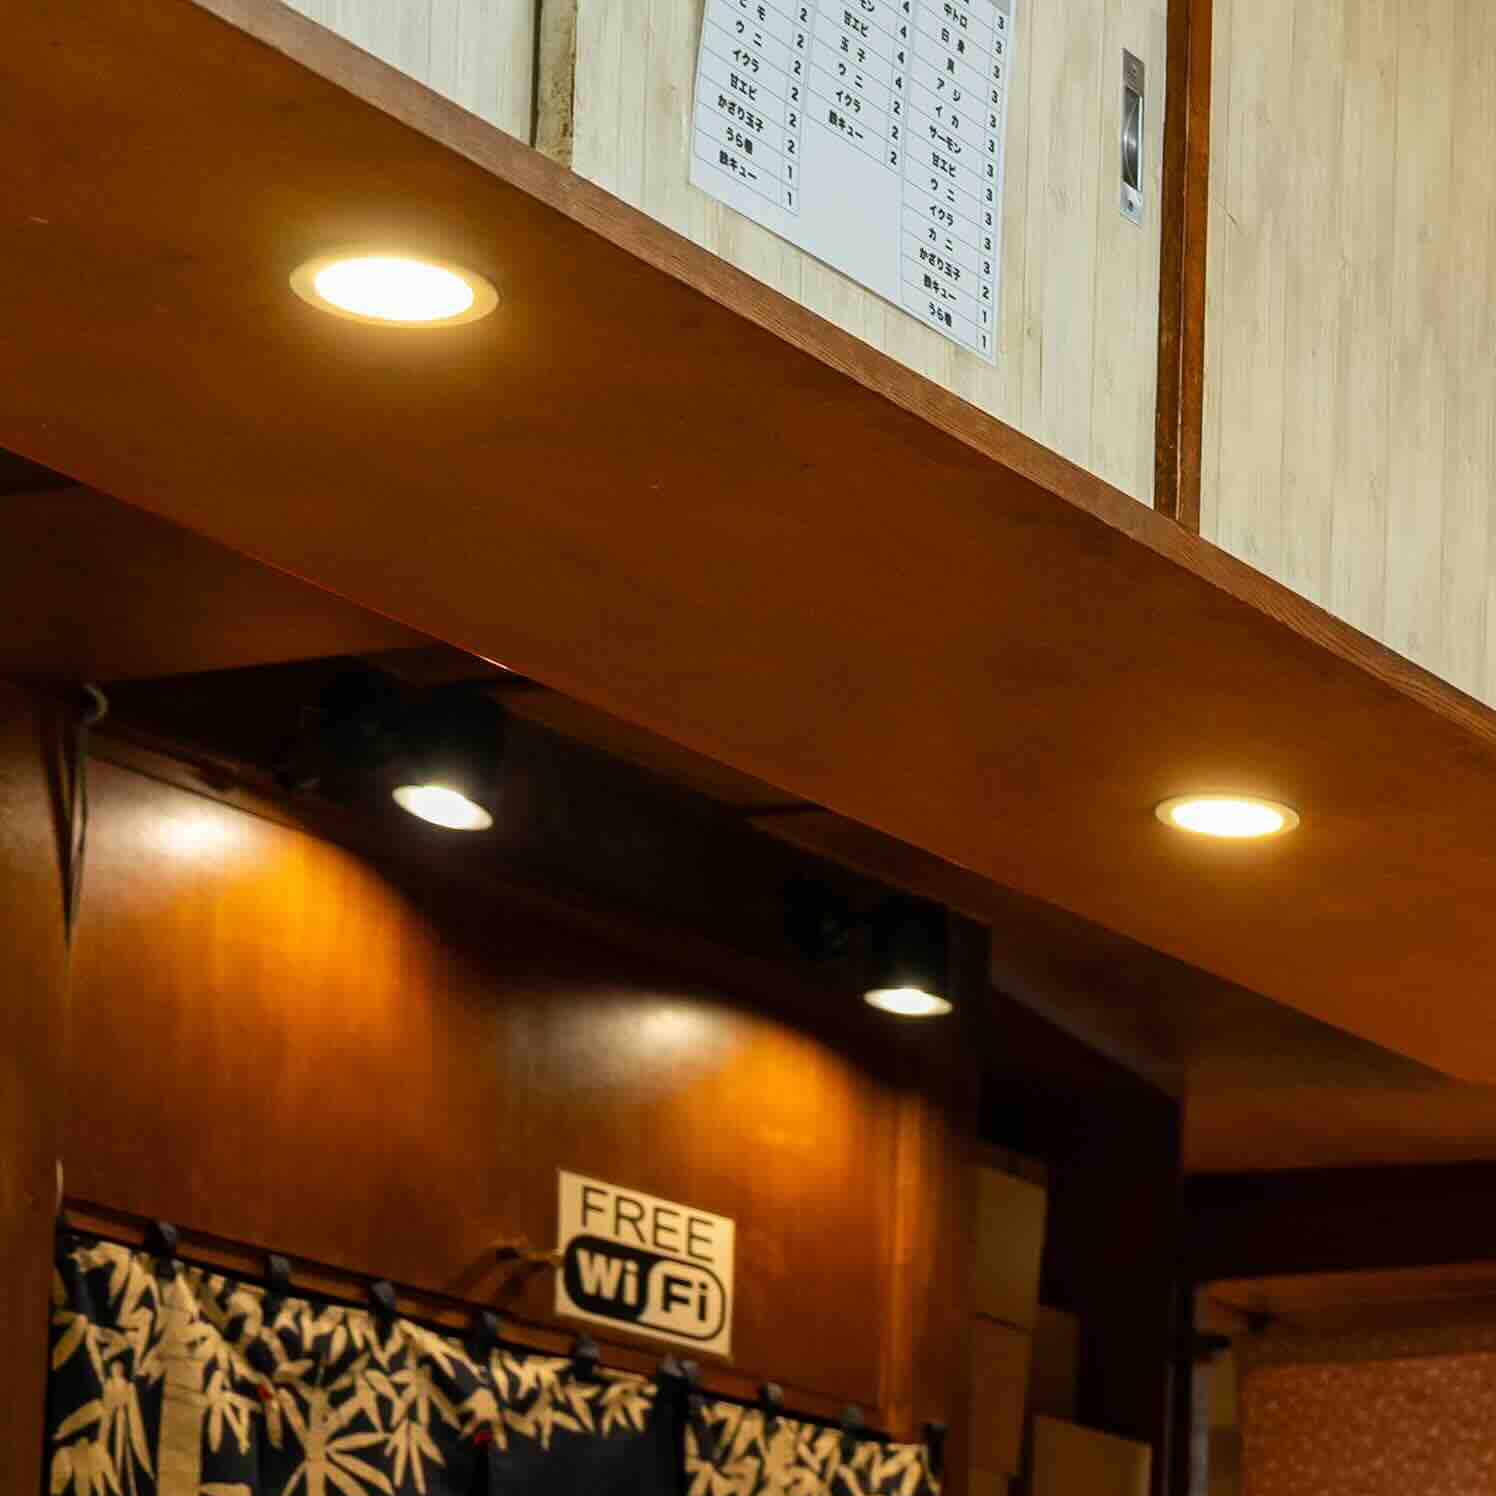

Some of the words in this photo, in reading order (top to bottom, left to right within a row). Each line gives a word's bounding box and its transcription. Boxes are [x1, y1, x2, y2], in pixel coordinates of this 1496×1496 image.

[799, 7, 808, 23] 2
[902, 1, 910, 14] 4
[998, 15, 1005, 30] 3
[899, 25, 907, 39] 4
[796, 33, 805, 49] 2
[995, 40, 1002, 55] 3
[897, 51, 905, 65] 4
[733, 49, 759, 73] イクラ
[791, 87, 799, 102] 2
[793, 60, 801, 76] 2
[993, 65, 1000, 79] 3
[895, 76, 902, 89] 4
[991, 89, 999, 104] 3
[893, 100, 901, 115] 2
[789, 112, 797, 128] 2
[835, 90, 861, 113] イクラ
[891, 125, 899, 141] 2
[990, 114, 997, 129] 3
[787, 139, 795, 155] 2
[988, 139, 995, 153] 3
[890, 151, 897, 166] 2
[787, 165, 793, 179] 1
[986, 163, 994, 178] 3
[787, 191, 792, 206] 1
[985, 188, 993, 202] 3
[984, 212, 992, 226] 3
[929, 205, 954, 227] イクラ
[984, 237, 991, 251] 3
[983, 261, 991, 275] 3
[982, 285, 990, 300] 2
[982, 310, 987, 323] 1
[982, 335, 986, 349] 1
[580, 1184, 714, 1264] FREE
